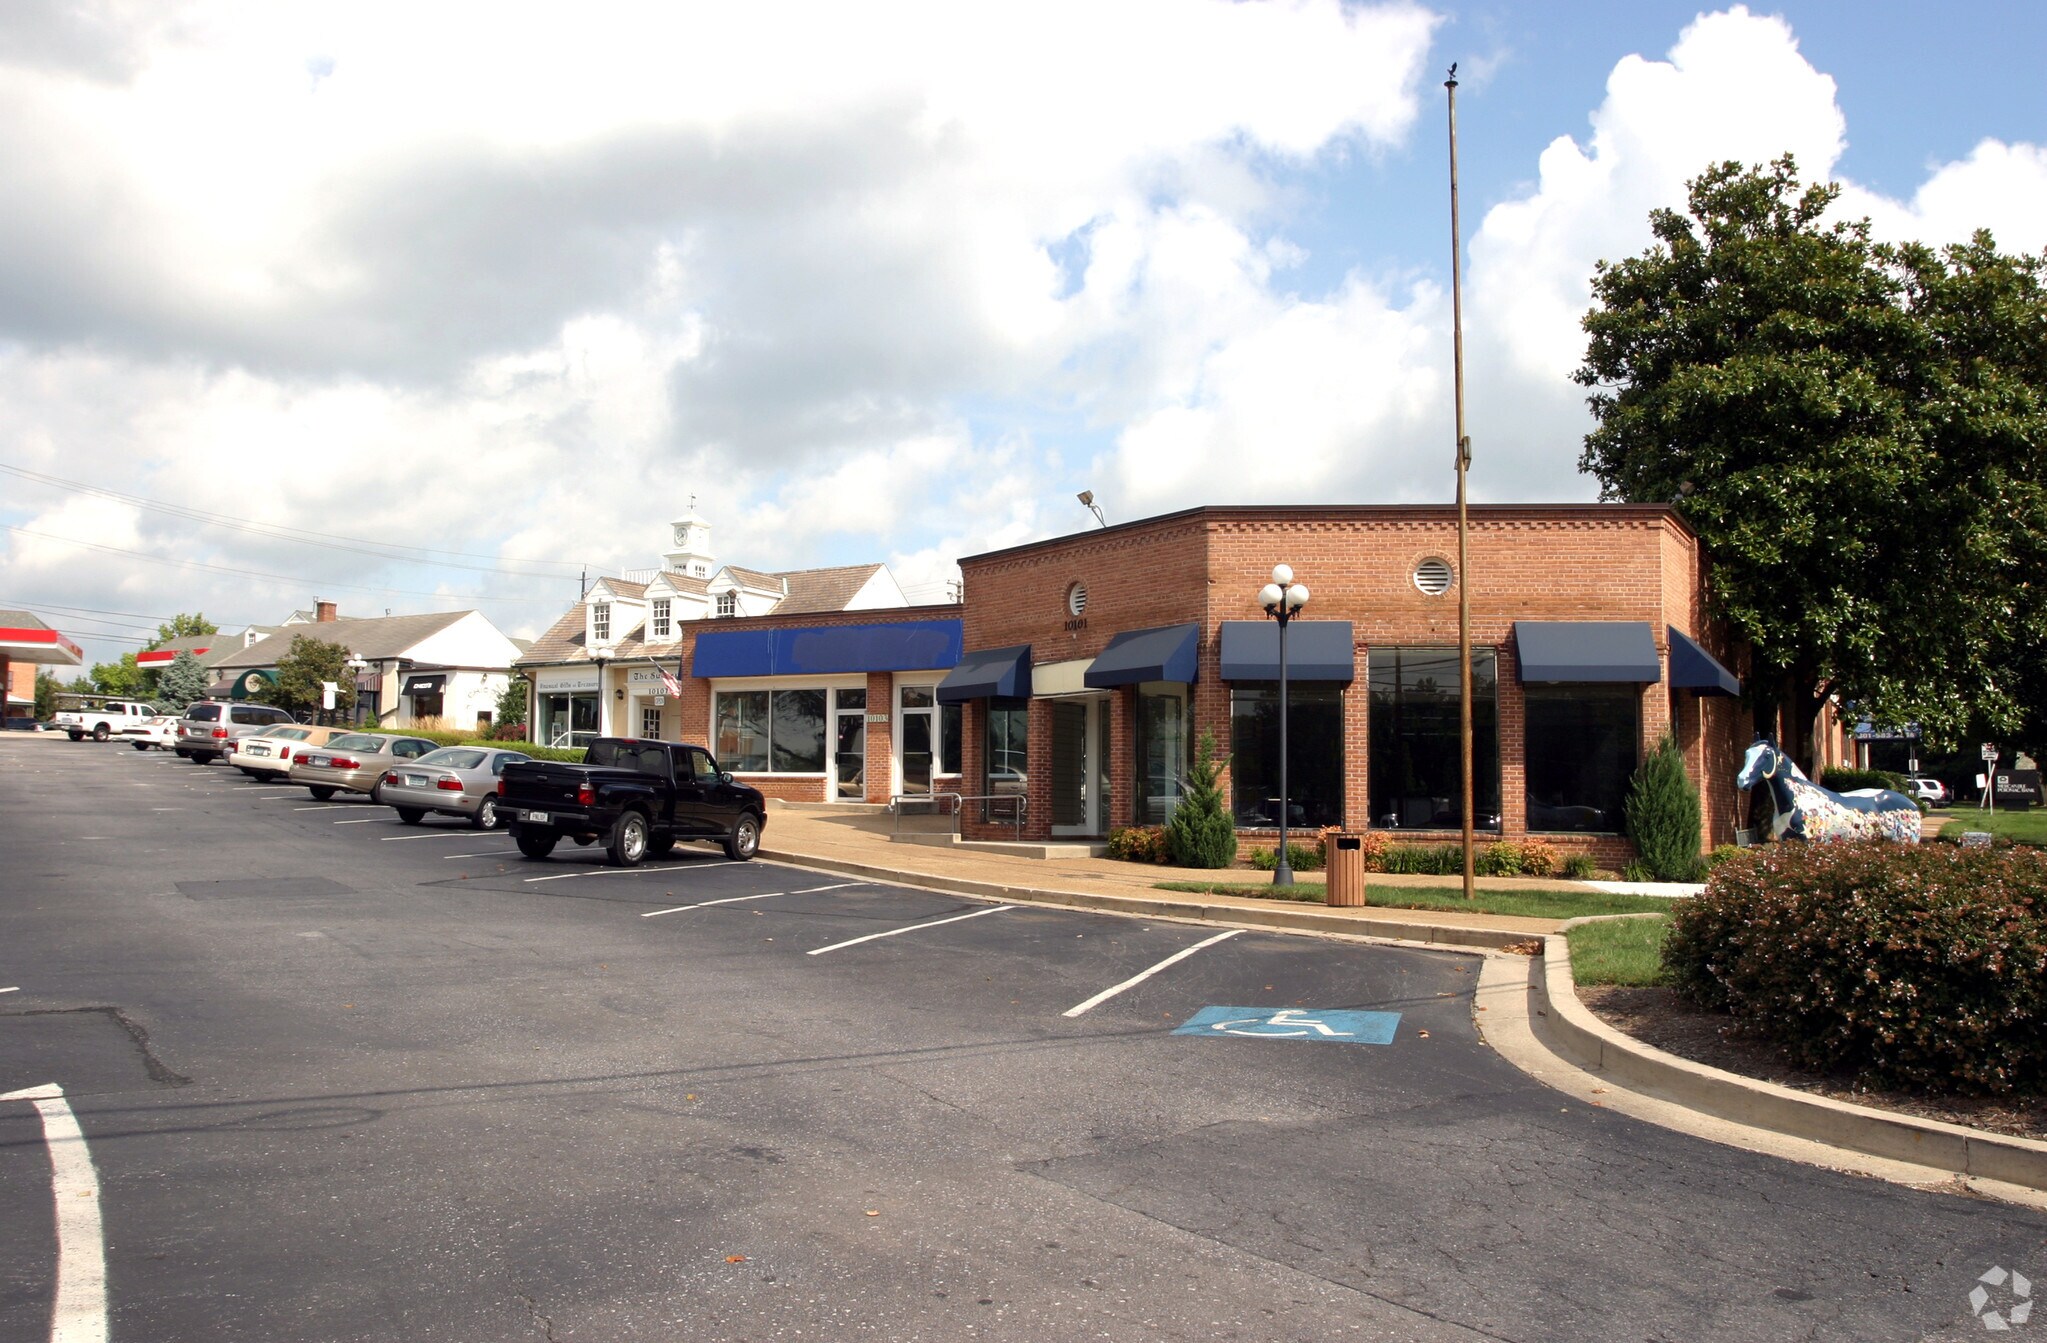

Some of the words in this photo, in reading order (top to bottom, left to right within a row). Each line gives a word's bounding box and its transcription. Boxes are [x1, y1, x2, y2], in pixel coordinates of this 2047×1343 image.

[1064, 618, 1087, 631] 10101
[633, 672, 648, 680] The
[867, 714, 888, 722] 10103
